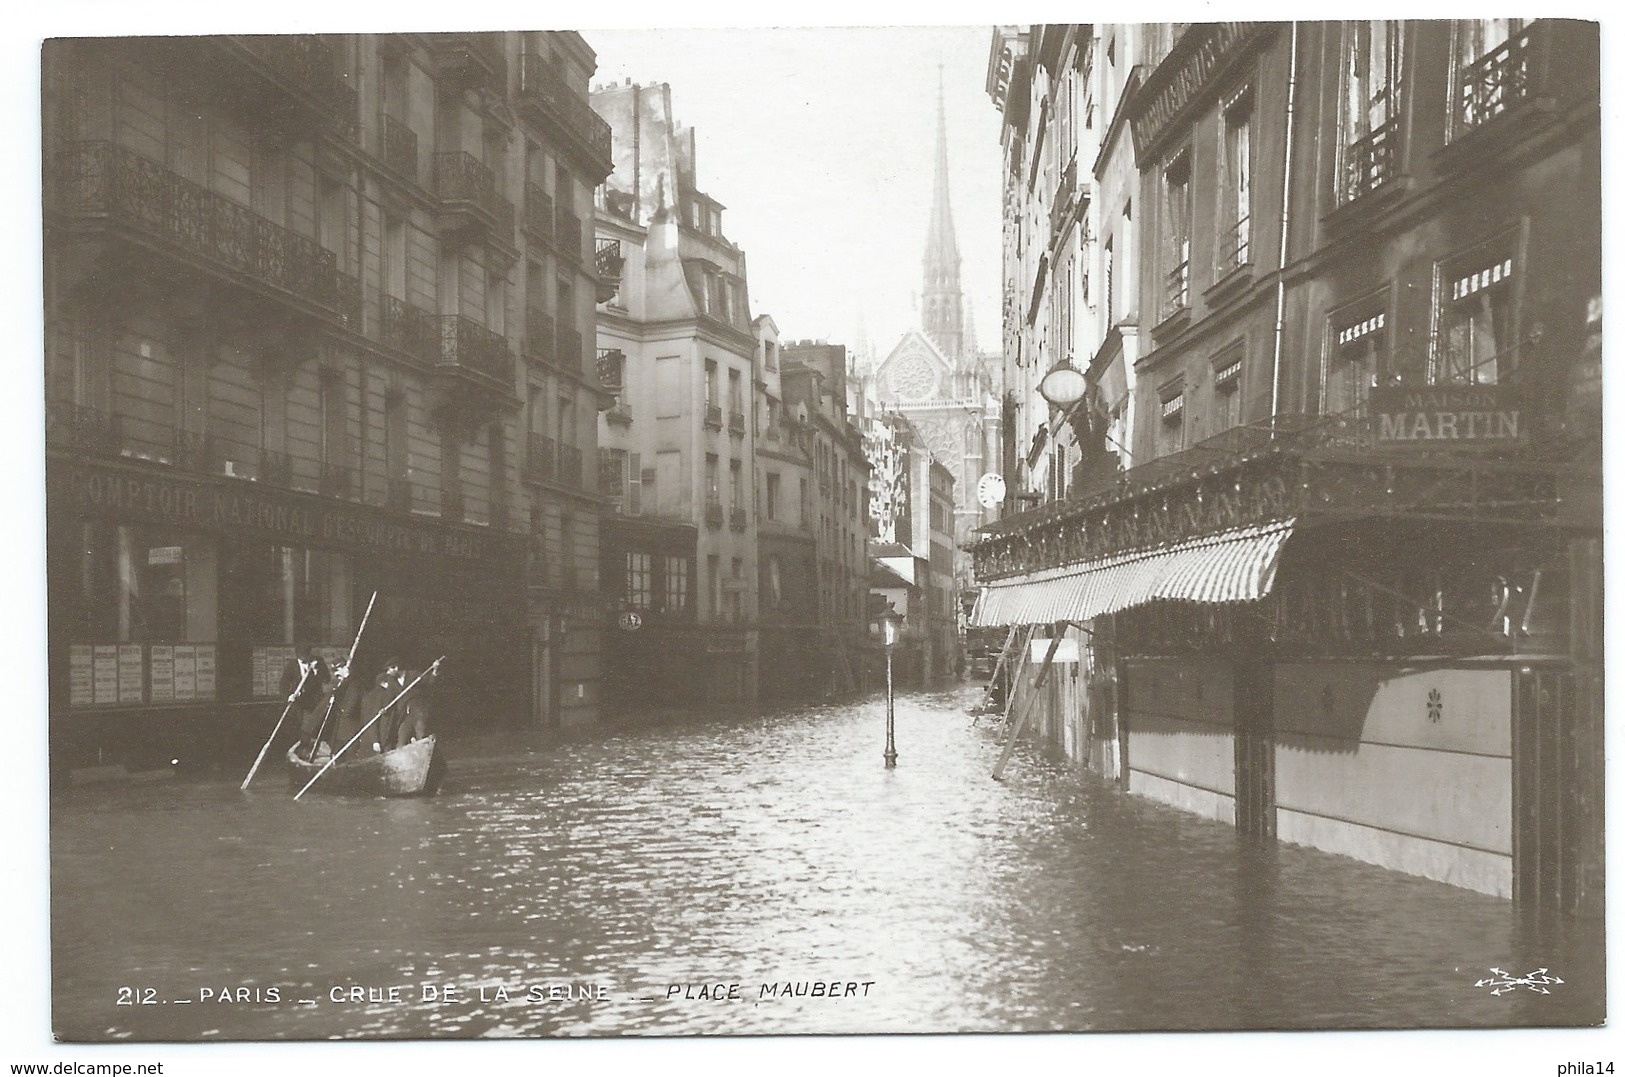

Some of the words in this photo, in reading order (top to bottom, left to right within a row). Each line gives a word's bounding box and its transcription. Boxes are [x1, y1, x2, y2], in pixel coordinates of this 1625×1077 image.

[1404, 392, 1498, 408] MAISON
[1379, 410, 1521, 441] MARTIN
[69, 470, 197, 517] COMPTOIR
[213, 491, 313, 535] NATIONAL
